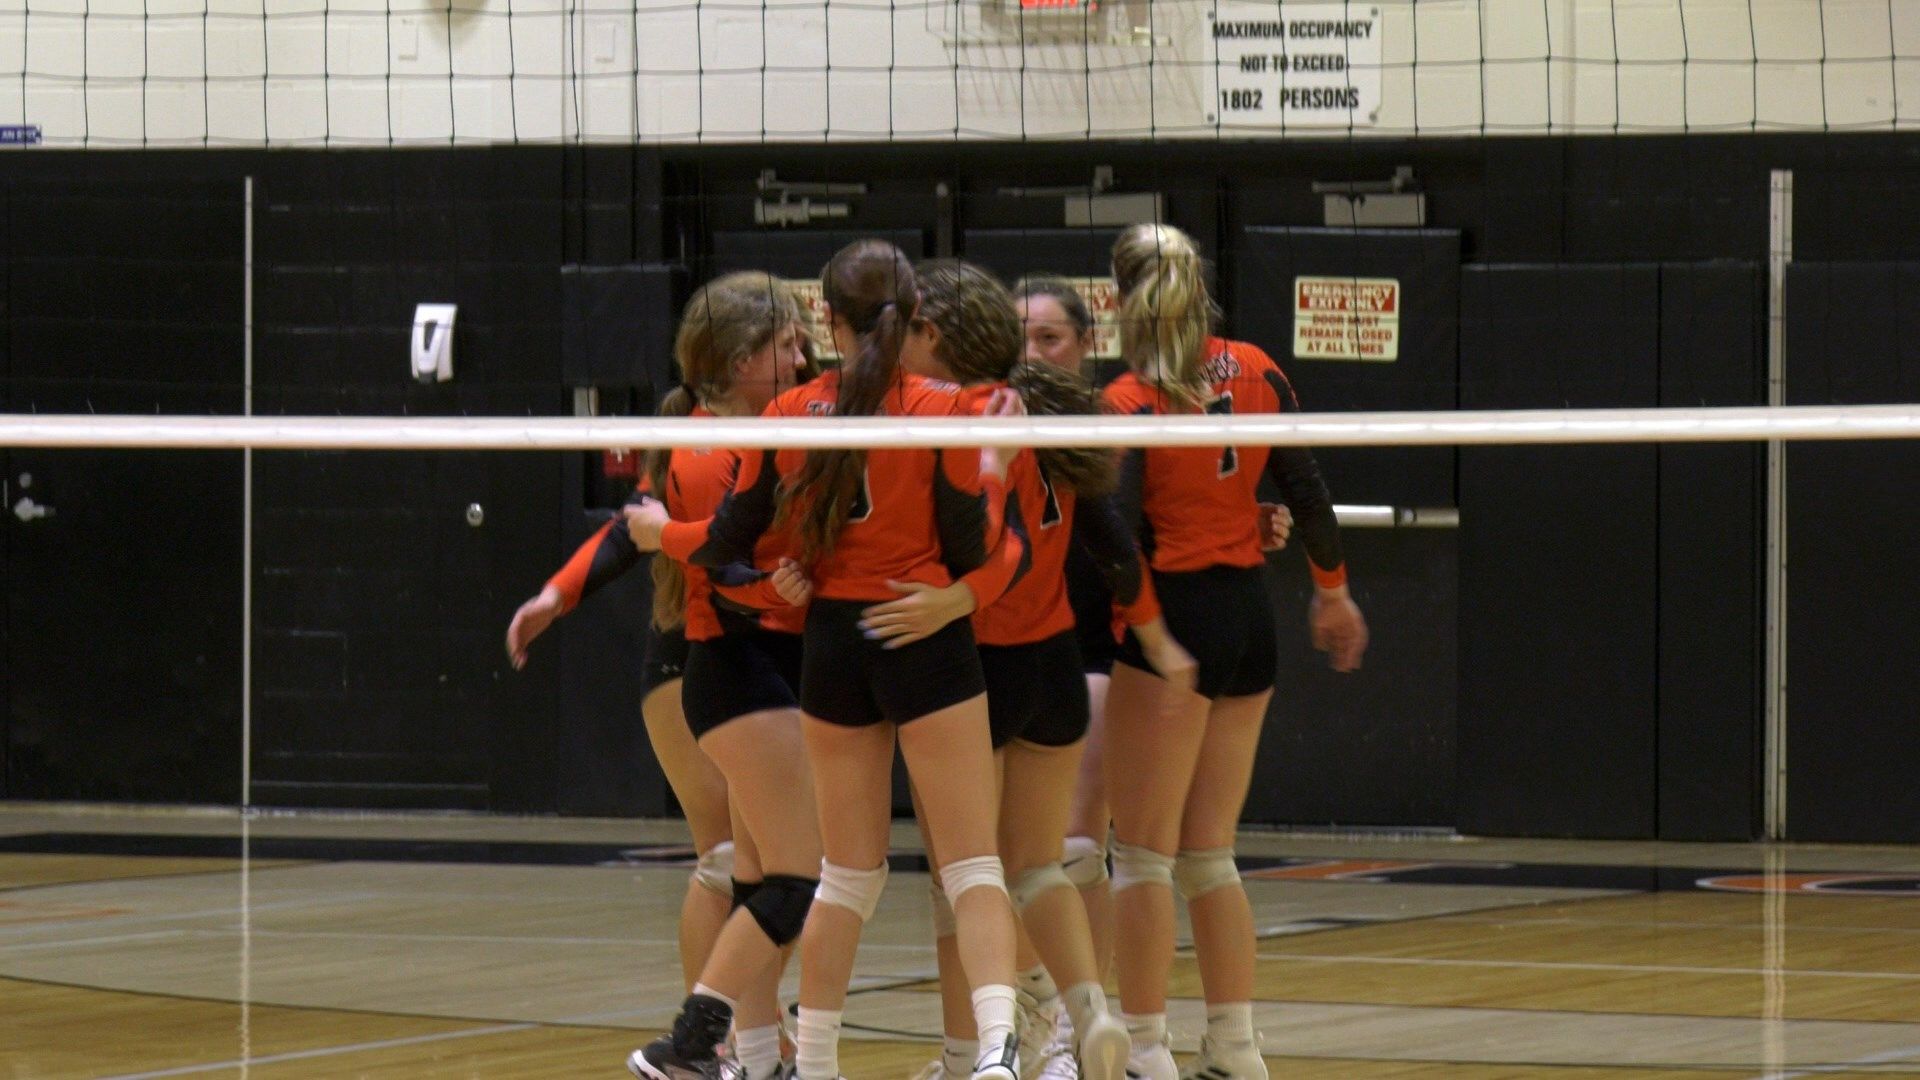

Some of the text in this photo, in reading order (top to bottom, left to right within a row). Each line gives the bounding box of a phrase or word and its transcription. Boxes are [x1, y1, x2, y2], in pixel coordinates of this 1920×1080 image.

[1213, 21, 1373, 38] MAXIMUM OCCUPANCY
[1240, 54, 1345, 72] NOT TO EXCEED
[1221, 88, 1360, 110] 1802 PERSONS
[1309, 297, 1340, 310] EXIT
[1300, 327, 1392, 341] REMAIN CLOSED
[1307, 341, 1384, 354] AT ALL TIMES
